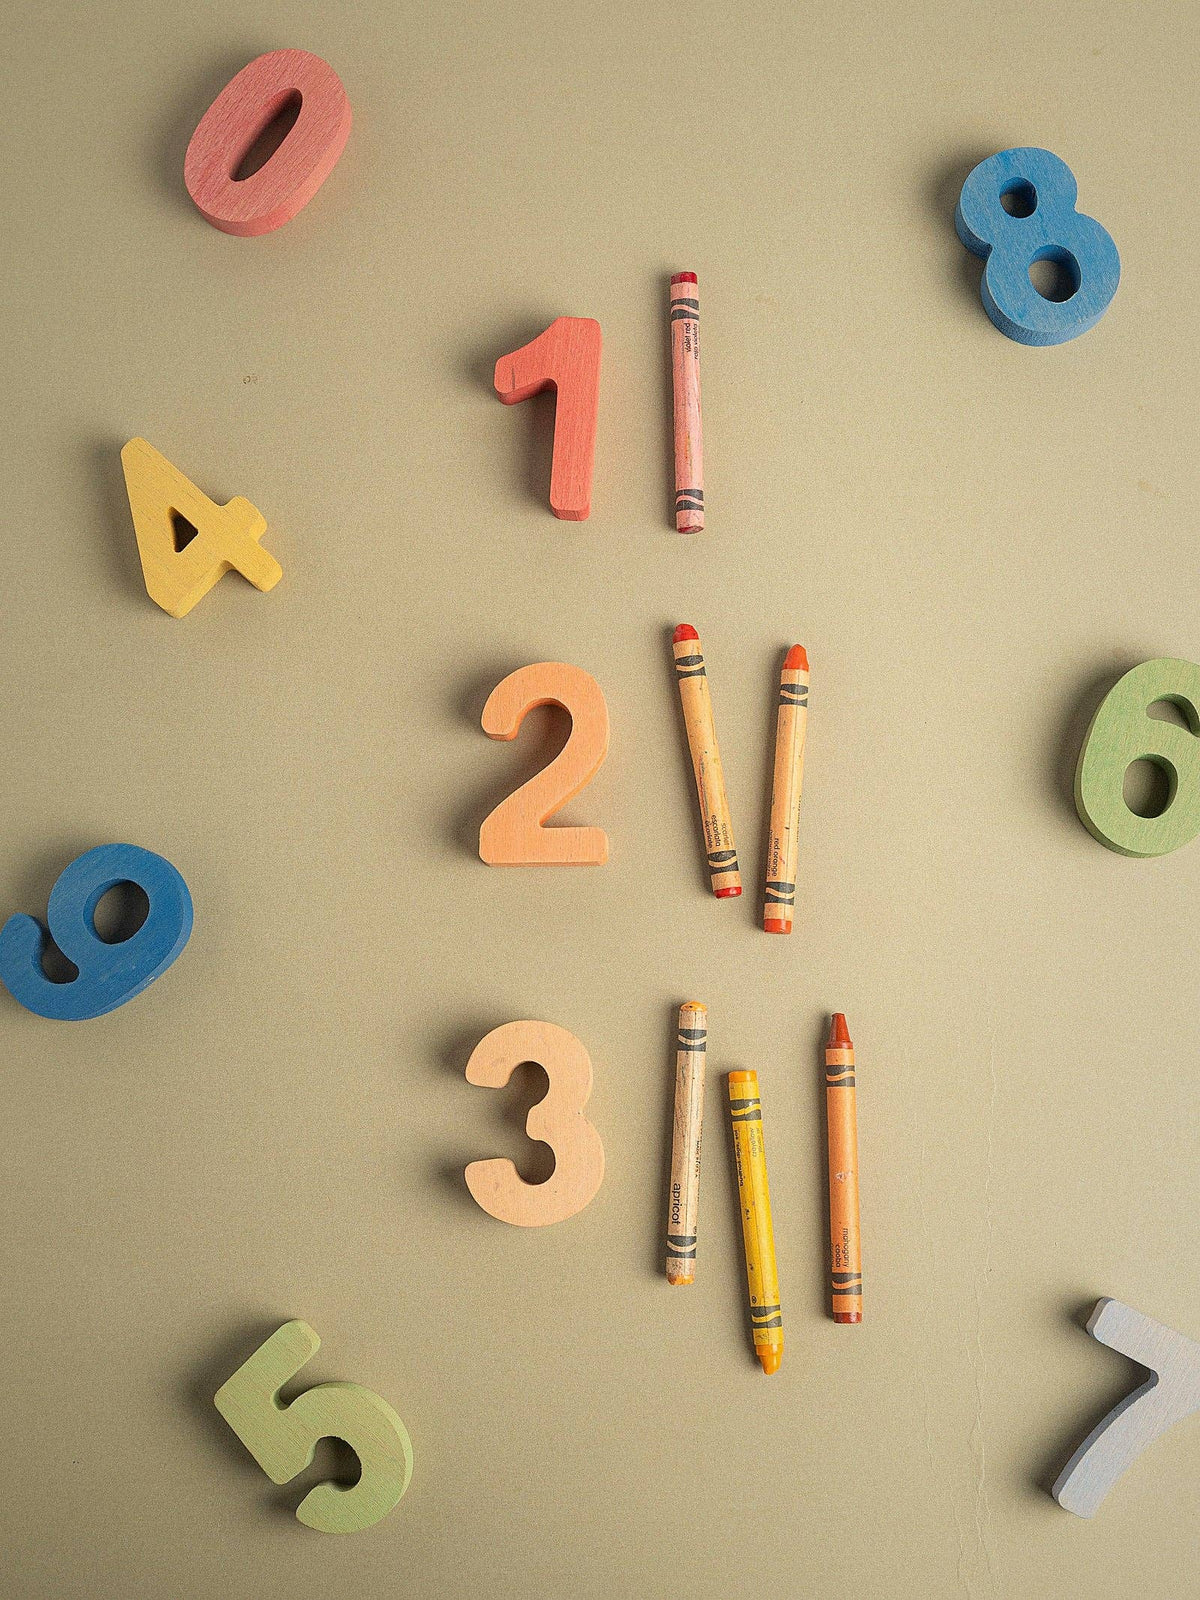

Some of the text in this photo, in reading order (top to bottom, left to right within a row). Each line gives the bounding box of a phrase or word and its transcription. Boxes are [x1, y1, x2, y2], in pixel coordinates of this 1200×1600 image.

[183, 48, 353, 237] 0
[954, 146, 1122, 347] 8
[493, 316, 603, 521] 1
[120, 437, 283, 618] 4
[478, 661, 609, 867] 2
[711, 815, 721, 847] escarlata
[1073, 658, 1200, 858] 6
[0, 843, 193, 1021] 9
[771, 851, 779, 877] orange
[465, 1020, 605, 1227] 3
[672, 1183, 682, 1224] apricot
[215, 1319, 413, 1534] 5
[1052, 1297, 1200, 1518] 7
